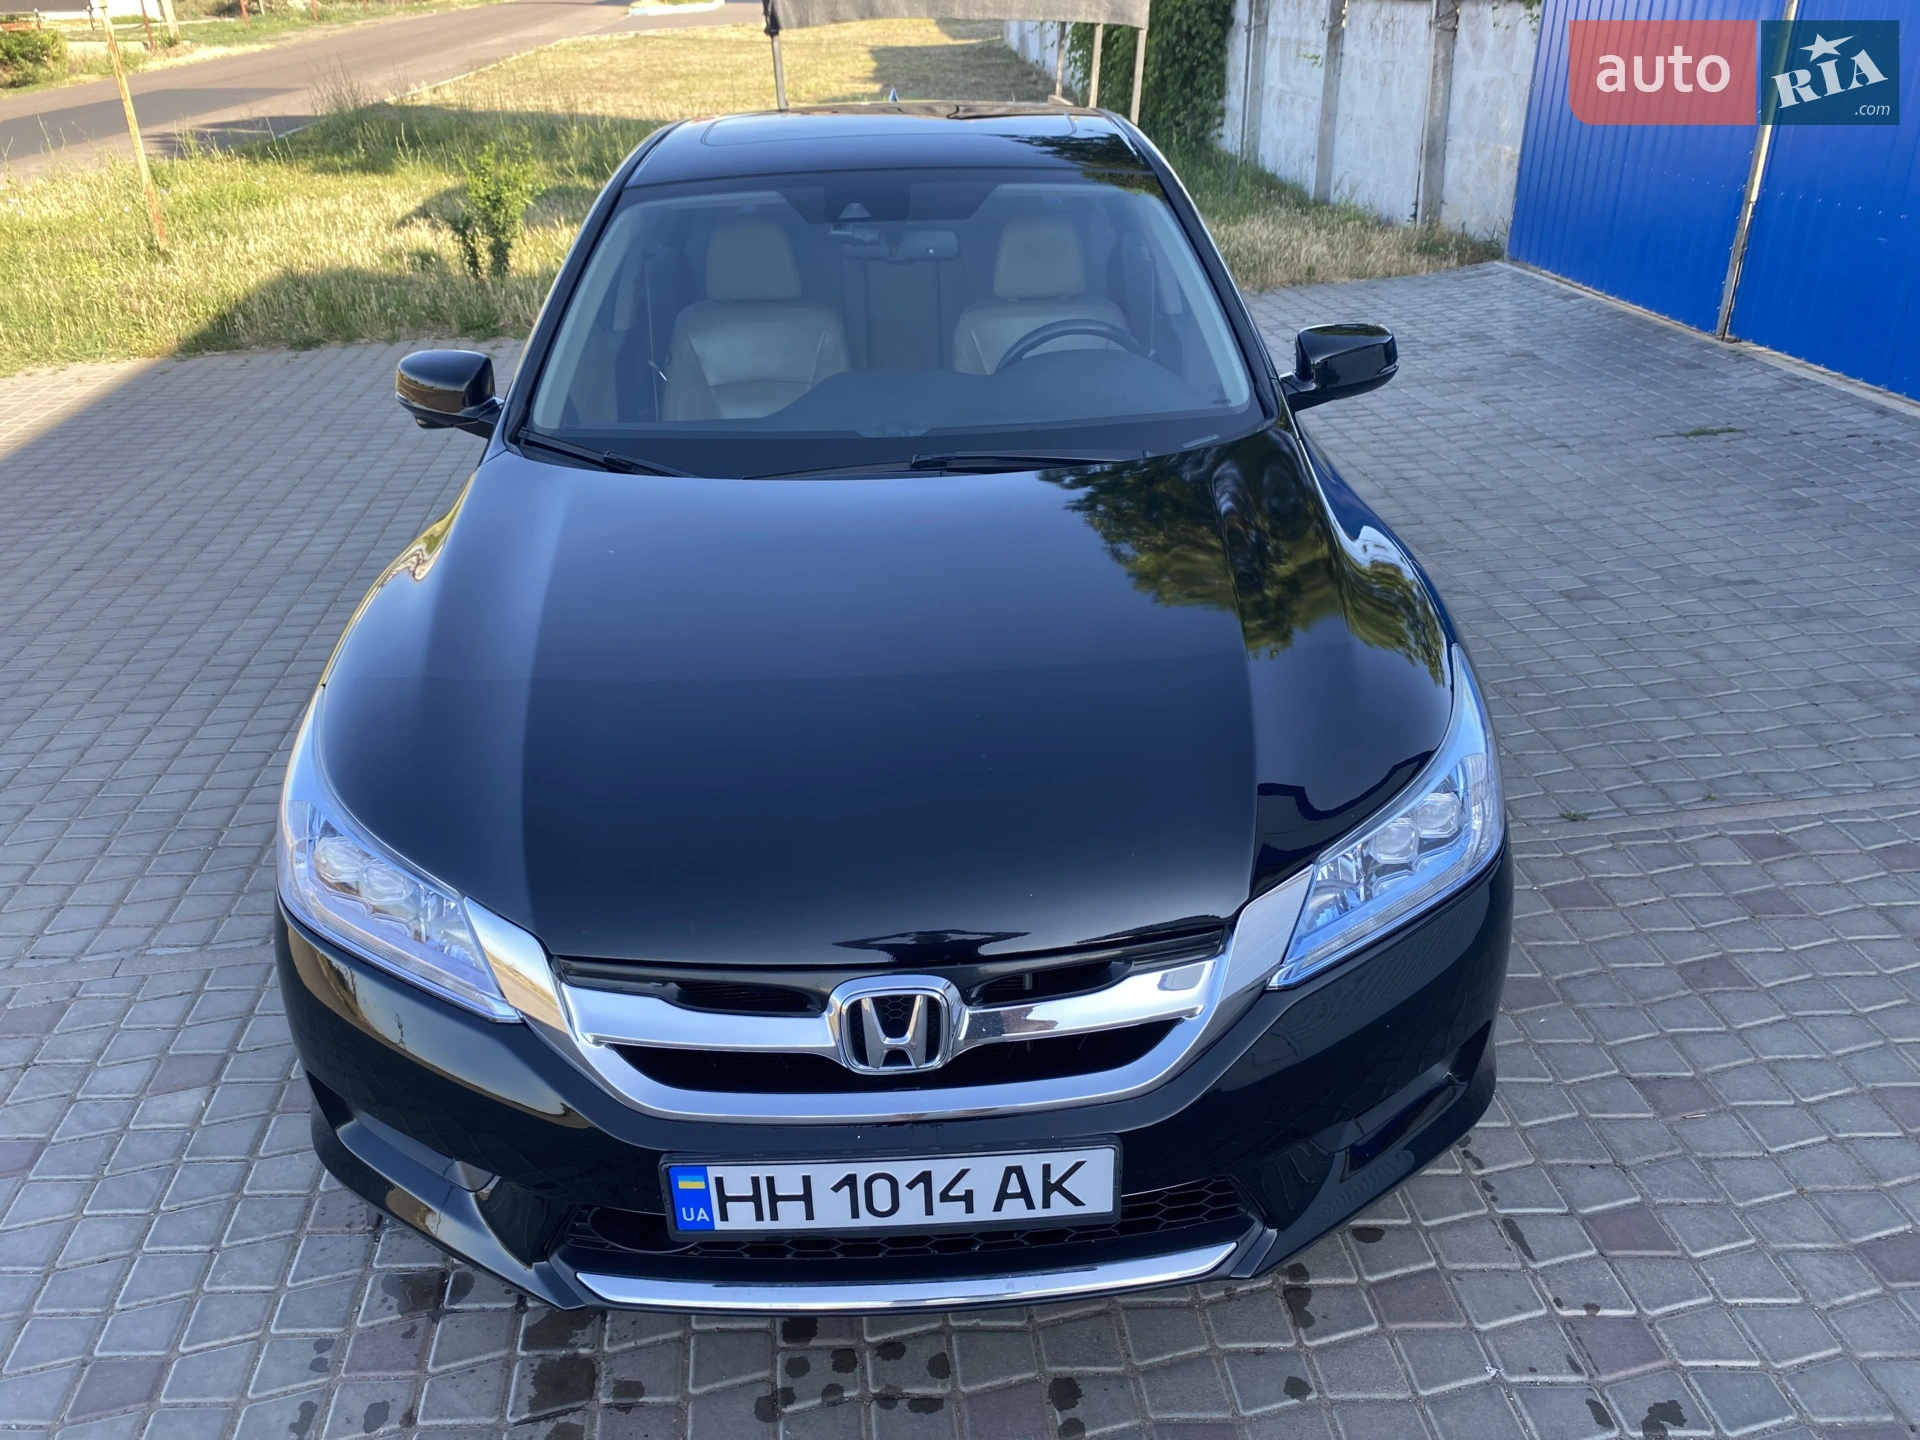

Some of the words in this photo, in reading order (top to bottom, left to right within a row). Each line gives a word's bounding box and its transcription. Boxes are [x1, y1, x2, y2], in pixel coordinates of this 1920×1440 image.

[714, 1174, 815, 1222] HH
[830, 1168, 975, 1219] 1014
[992, 1160, 1088, 1213] AK
[682, 1207, 710, 1222] UA
